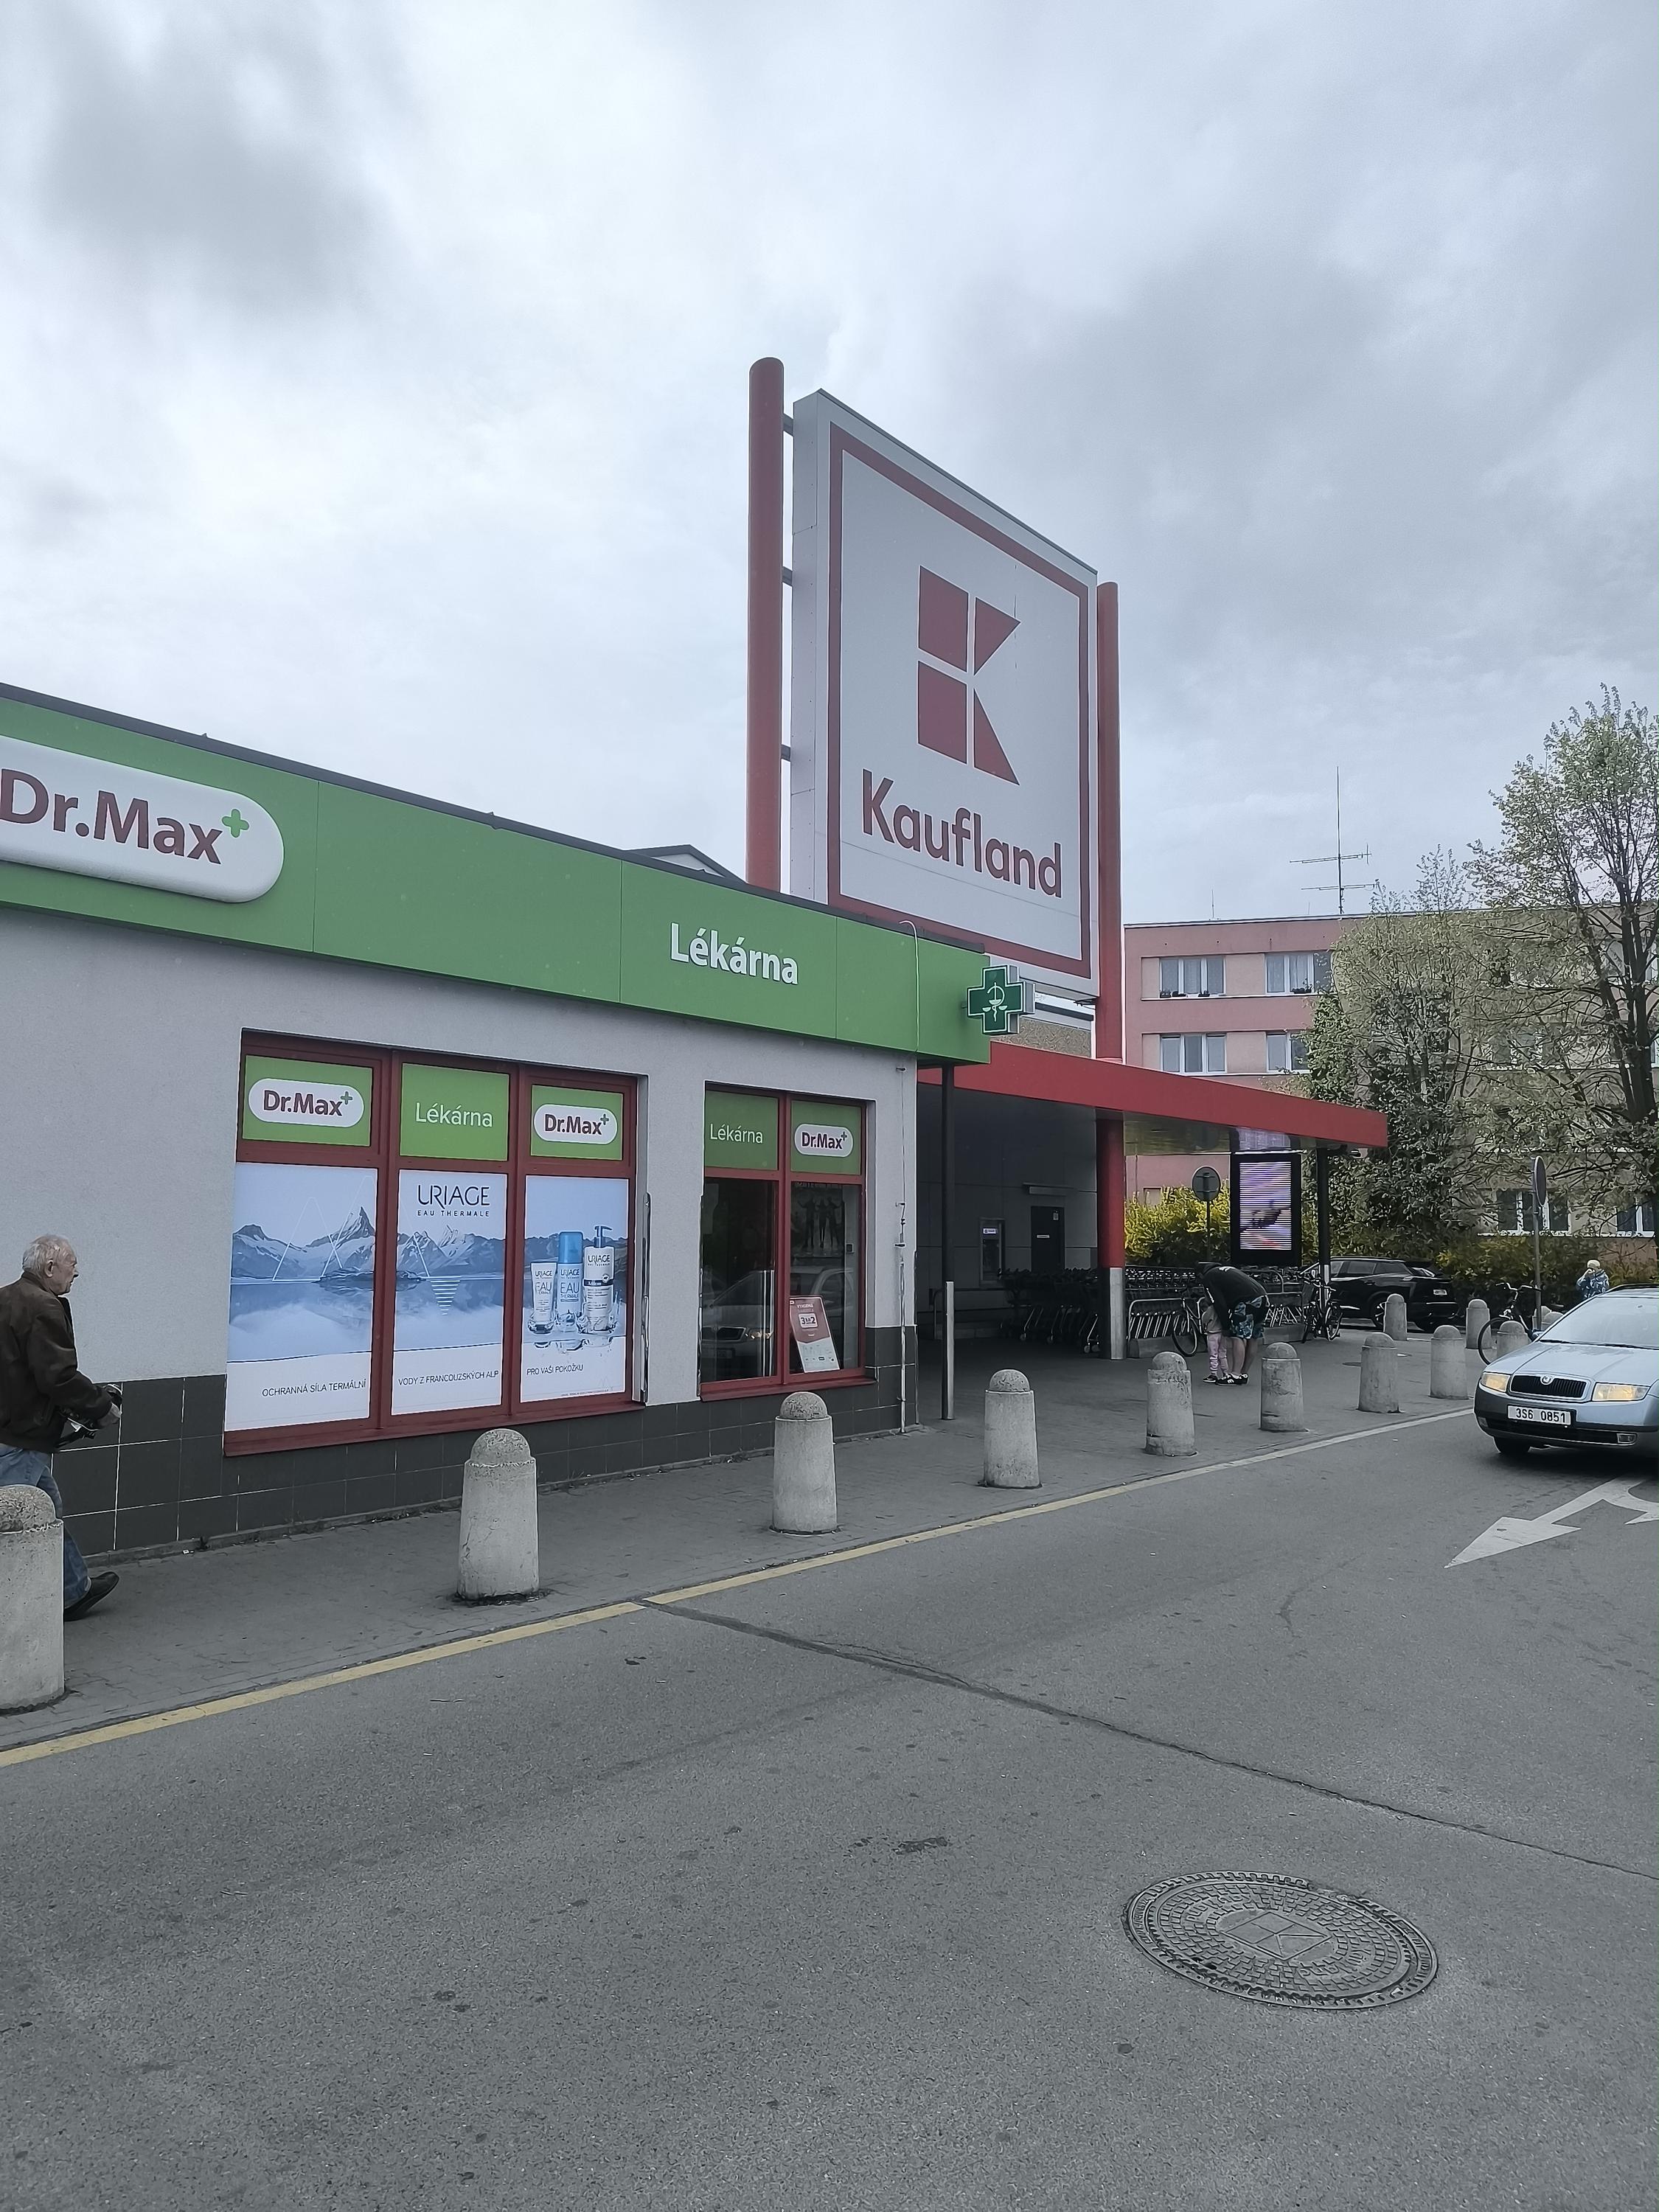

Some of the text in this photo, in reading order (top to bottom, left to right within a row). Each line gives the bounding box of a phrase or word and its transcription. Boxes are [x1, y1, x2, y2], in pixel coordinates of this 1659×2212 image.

[862, 768, 1062, 899] Kaufland
[669, 922, 799, 986] Lékárna
[415, 1102, 493, 1128] Lékárna
[709, 1123, 764, 1144] Lékárna
[417, 1184, 490, 1209] URIAGE
[560, 1281, 580, 1294] EAU
[398, 1370, 499, 1385] VODY Z FRANCOUZSKÝCH ALP
[540, 1365, 554, 1374] VAŠI
[555, 1363, 584, 1373] POKOŽKU
[262, 1378, 366, 1397] OCHRANNÁ SÍLA TERMÁLNÍ
[1516, 1408, 1566, 1424] 3S6 0851
